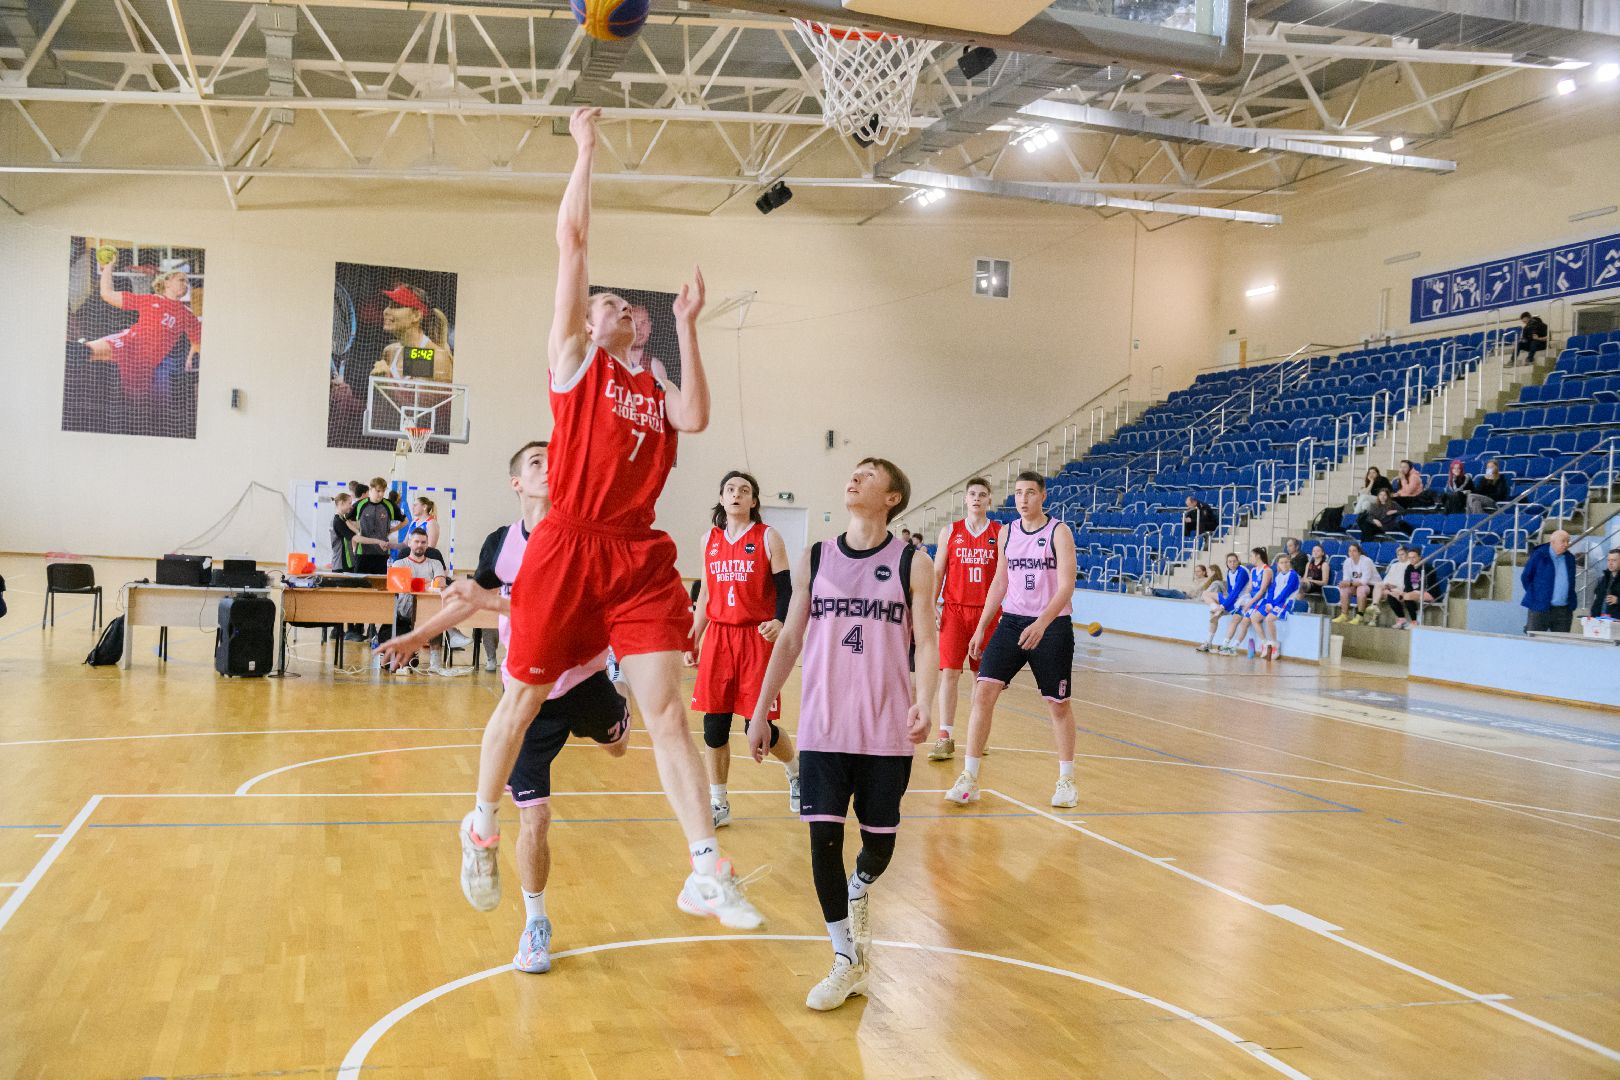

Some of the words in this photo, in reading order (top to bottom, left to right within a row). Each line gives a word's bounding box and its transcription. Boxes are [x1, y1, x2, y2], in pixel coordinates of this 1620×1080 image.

[410, 348, 433, 360] 6:42
[628, 428, 646, 462] 7
[955, 547, 995, 560] СПАРТАК
[968, 567, 982, 583] 10
[727, 585, 736, 607] 6
[811, 595, 905, 625] ФРЯЗИНО
[841, 624, 864, 654] 4
